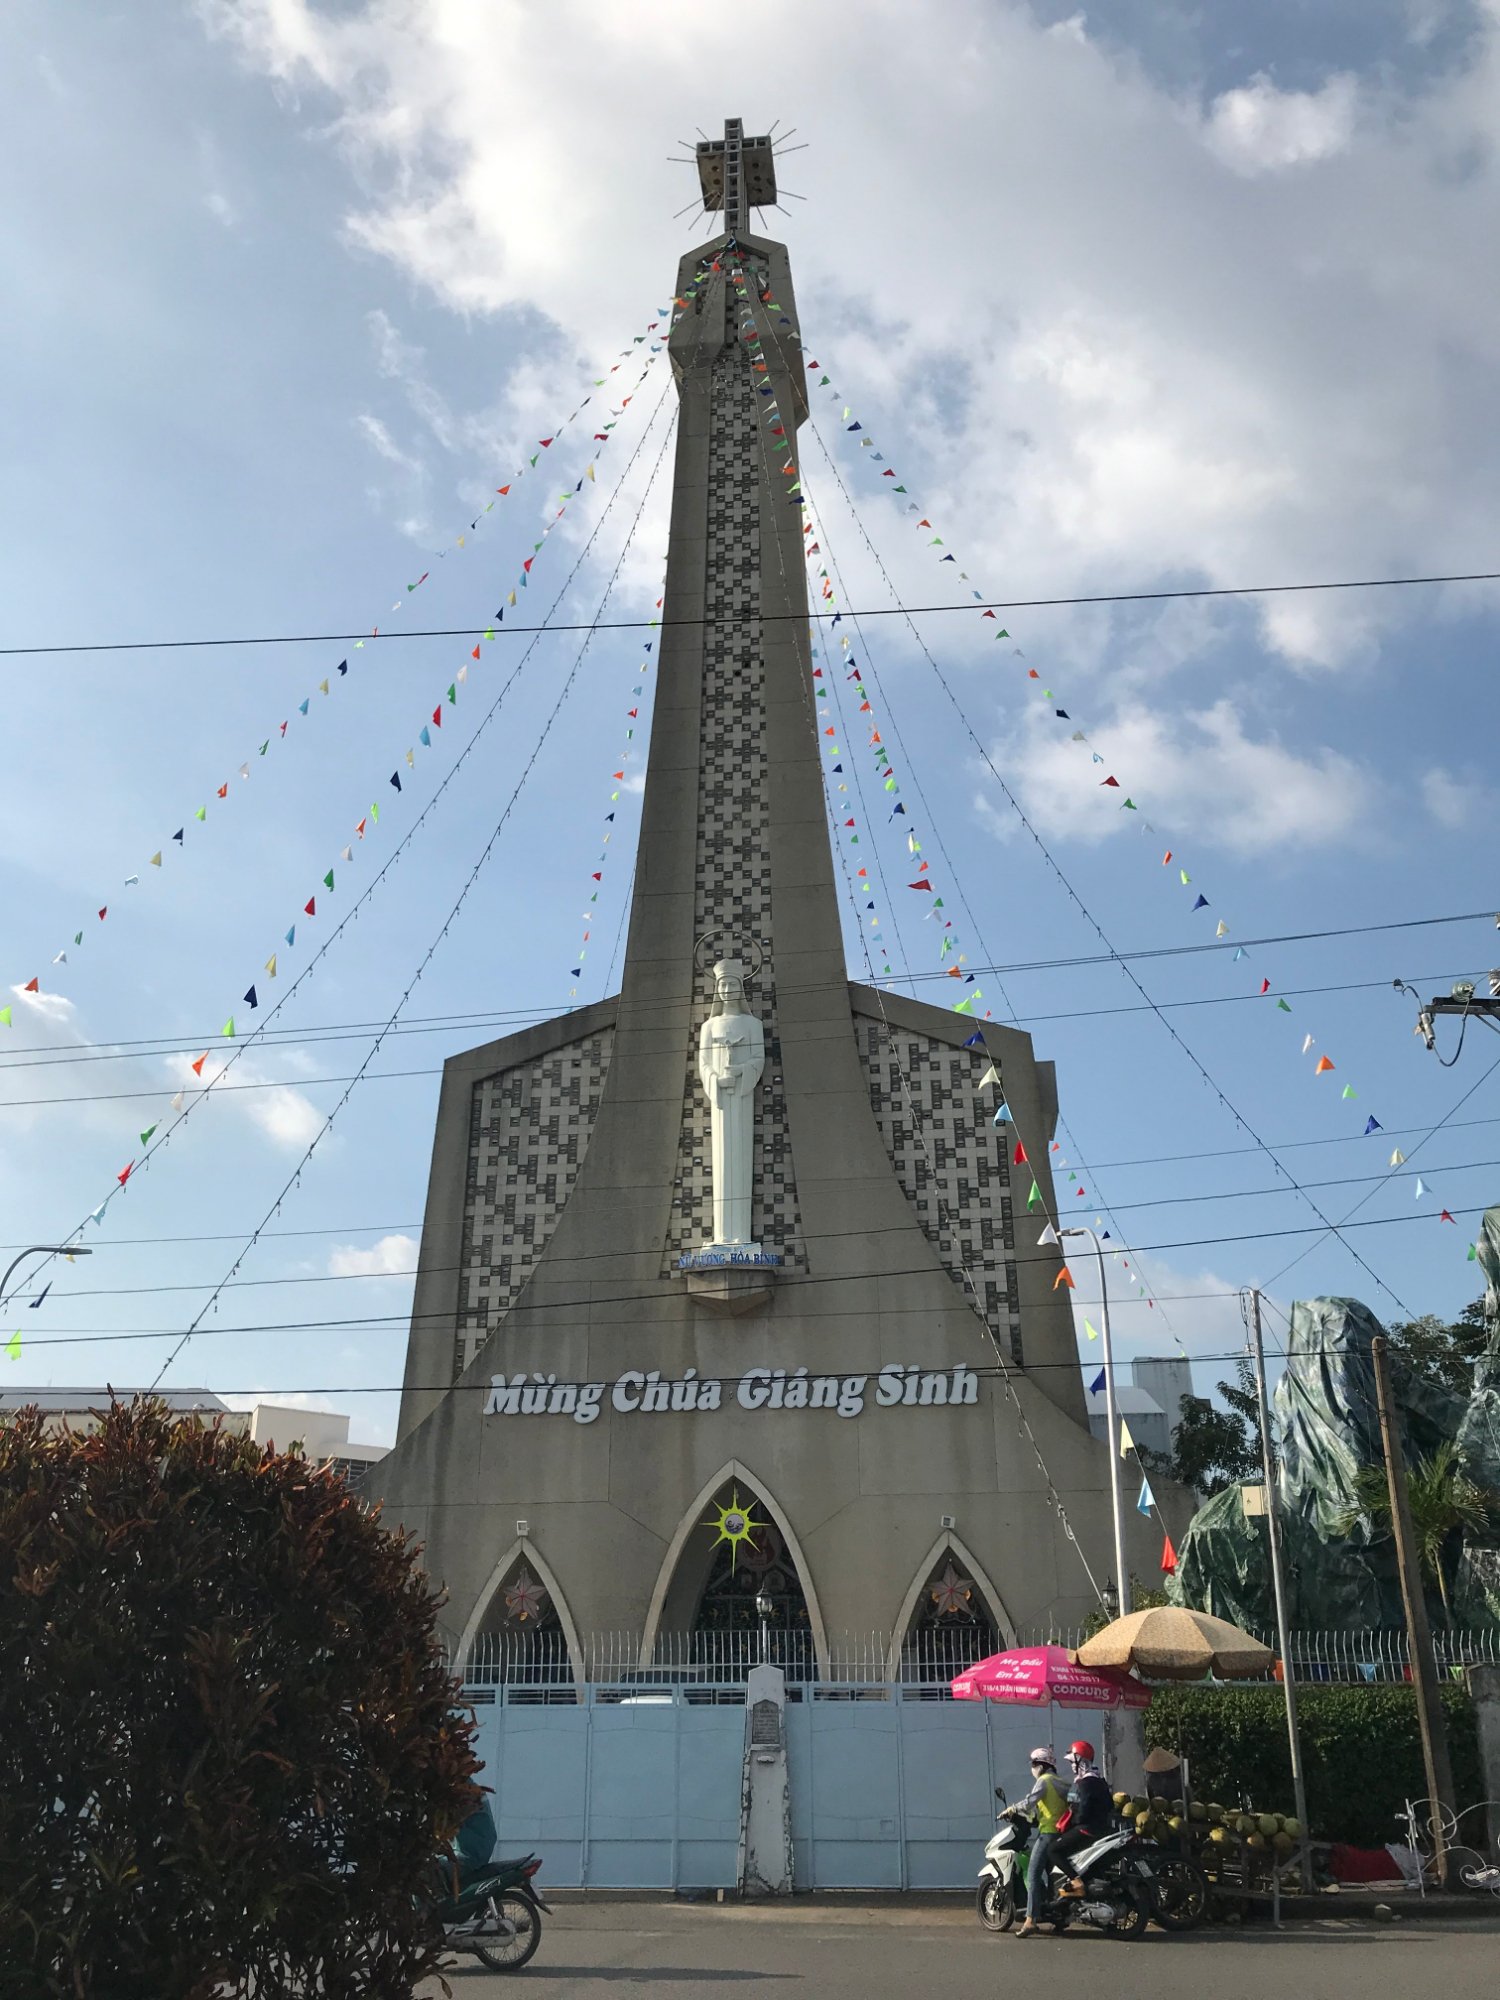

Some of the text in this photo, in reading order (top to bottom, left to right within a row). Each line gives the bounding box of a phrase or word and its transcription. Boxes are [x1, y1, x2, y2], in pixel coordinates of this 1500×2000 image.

[730, 1250, 751, 1264] HÒA
[483, 1363, 978, 1424] Mừng Chúa Giáng Sinh
[995, 1671, 1032, 1679] Em Bé
